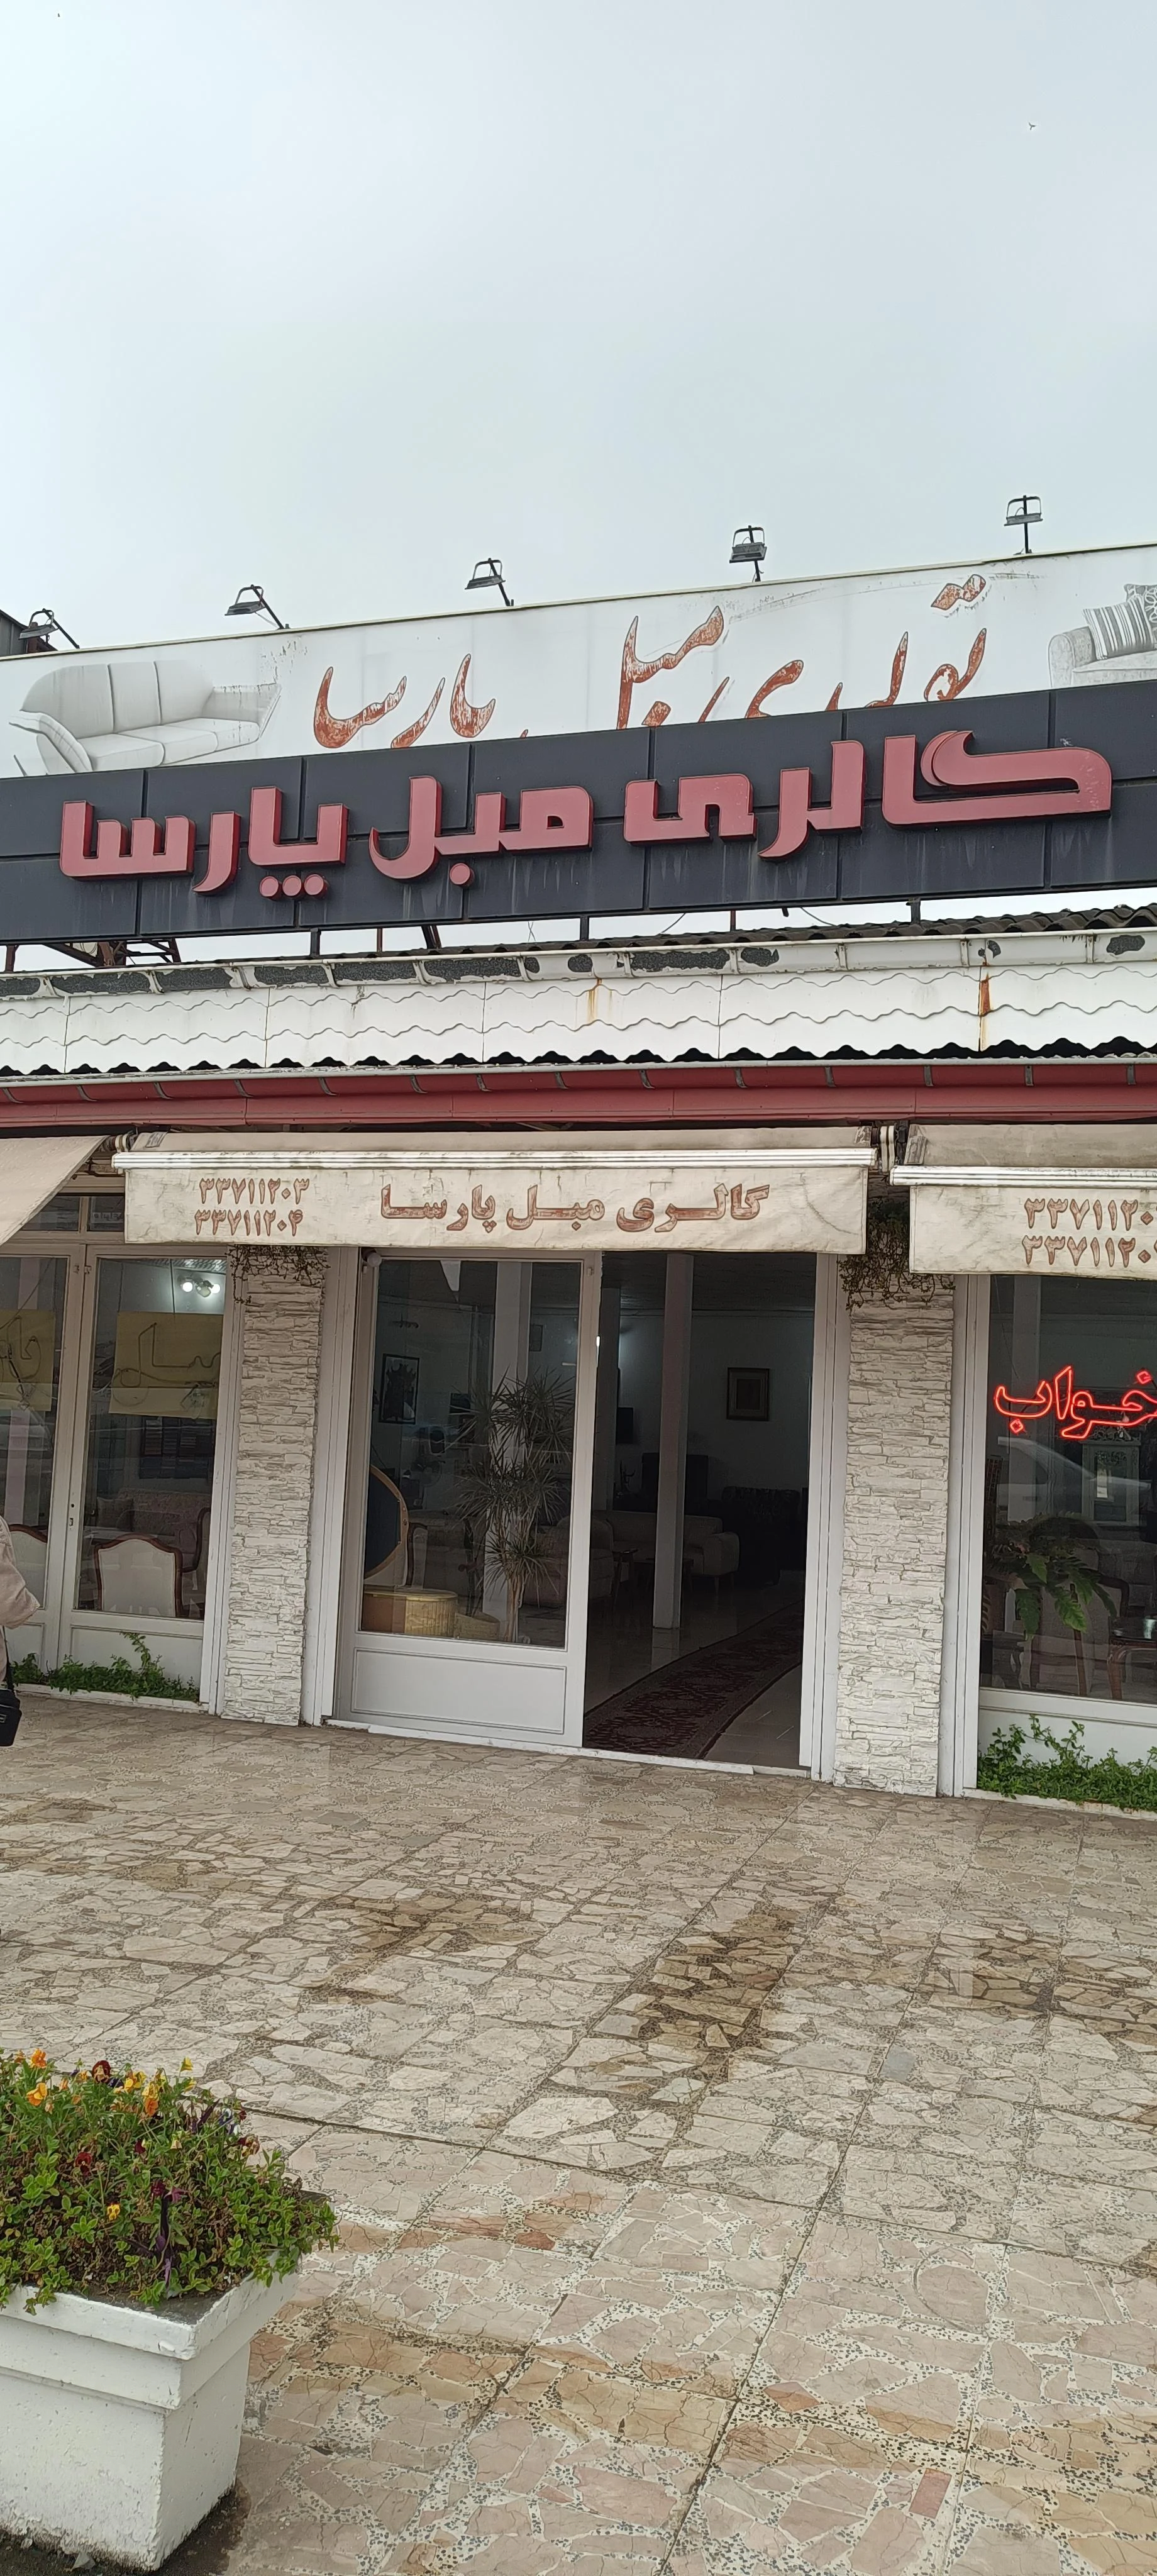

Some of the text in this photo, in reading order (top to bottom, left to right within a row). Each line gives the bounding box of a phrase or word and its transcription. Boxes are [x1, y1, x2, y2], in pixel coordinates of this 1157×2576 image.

[60, 730, 1113, 899] گالری مبل پارسا
[199, 1178, 310, 1204] ۳۳۷۱۱۲۰۳
[194, 1209, 304, 1236] ۳۳۷۱۱۲۰۴
[380, 1183, 770, 1233] گالری مبل پارسا
[1024, 1198, 1157, 1231] ۳۳۷۱۱۲۰
[1022, 1235, 1157, 1267] ۳۳۷۱۱۲۰
